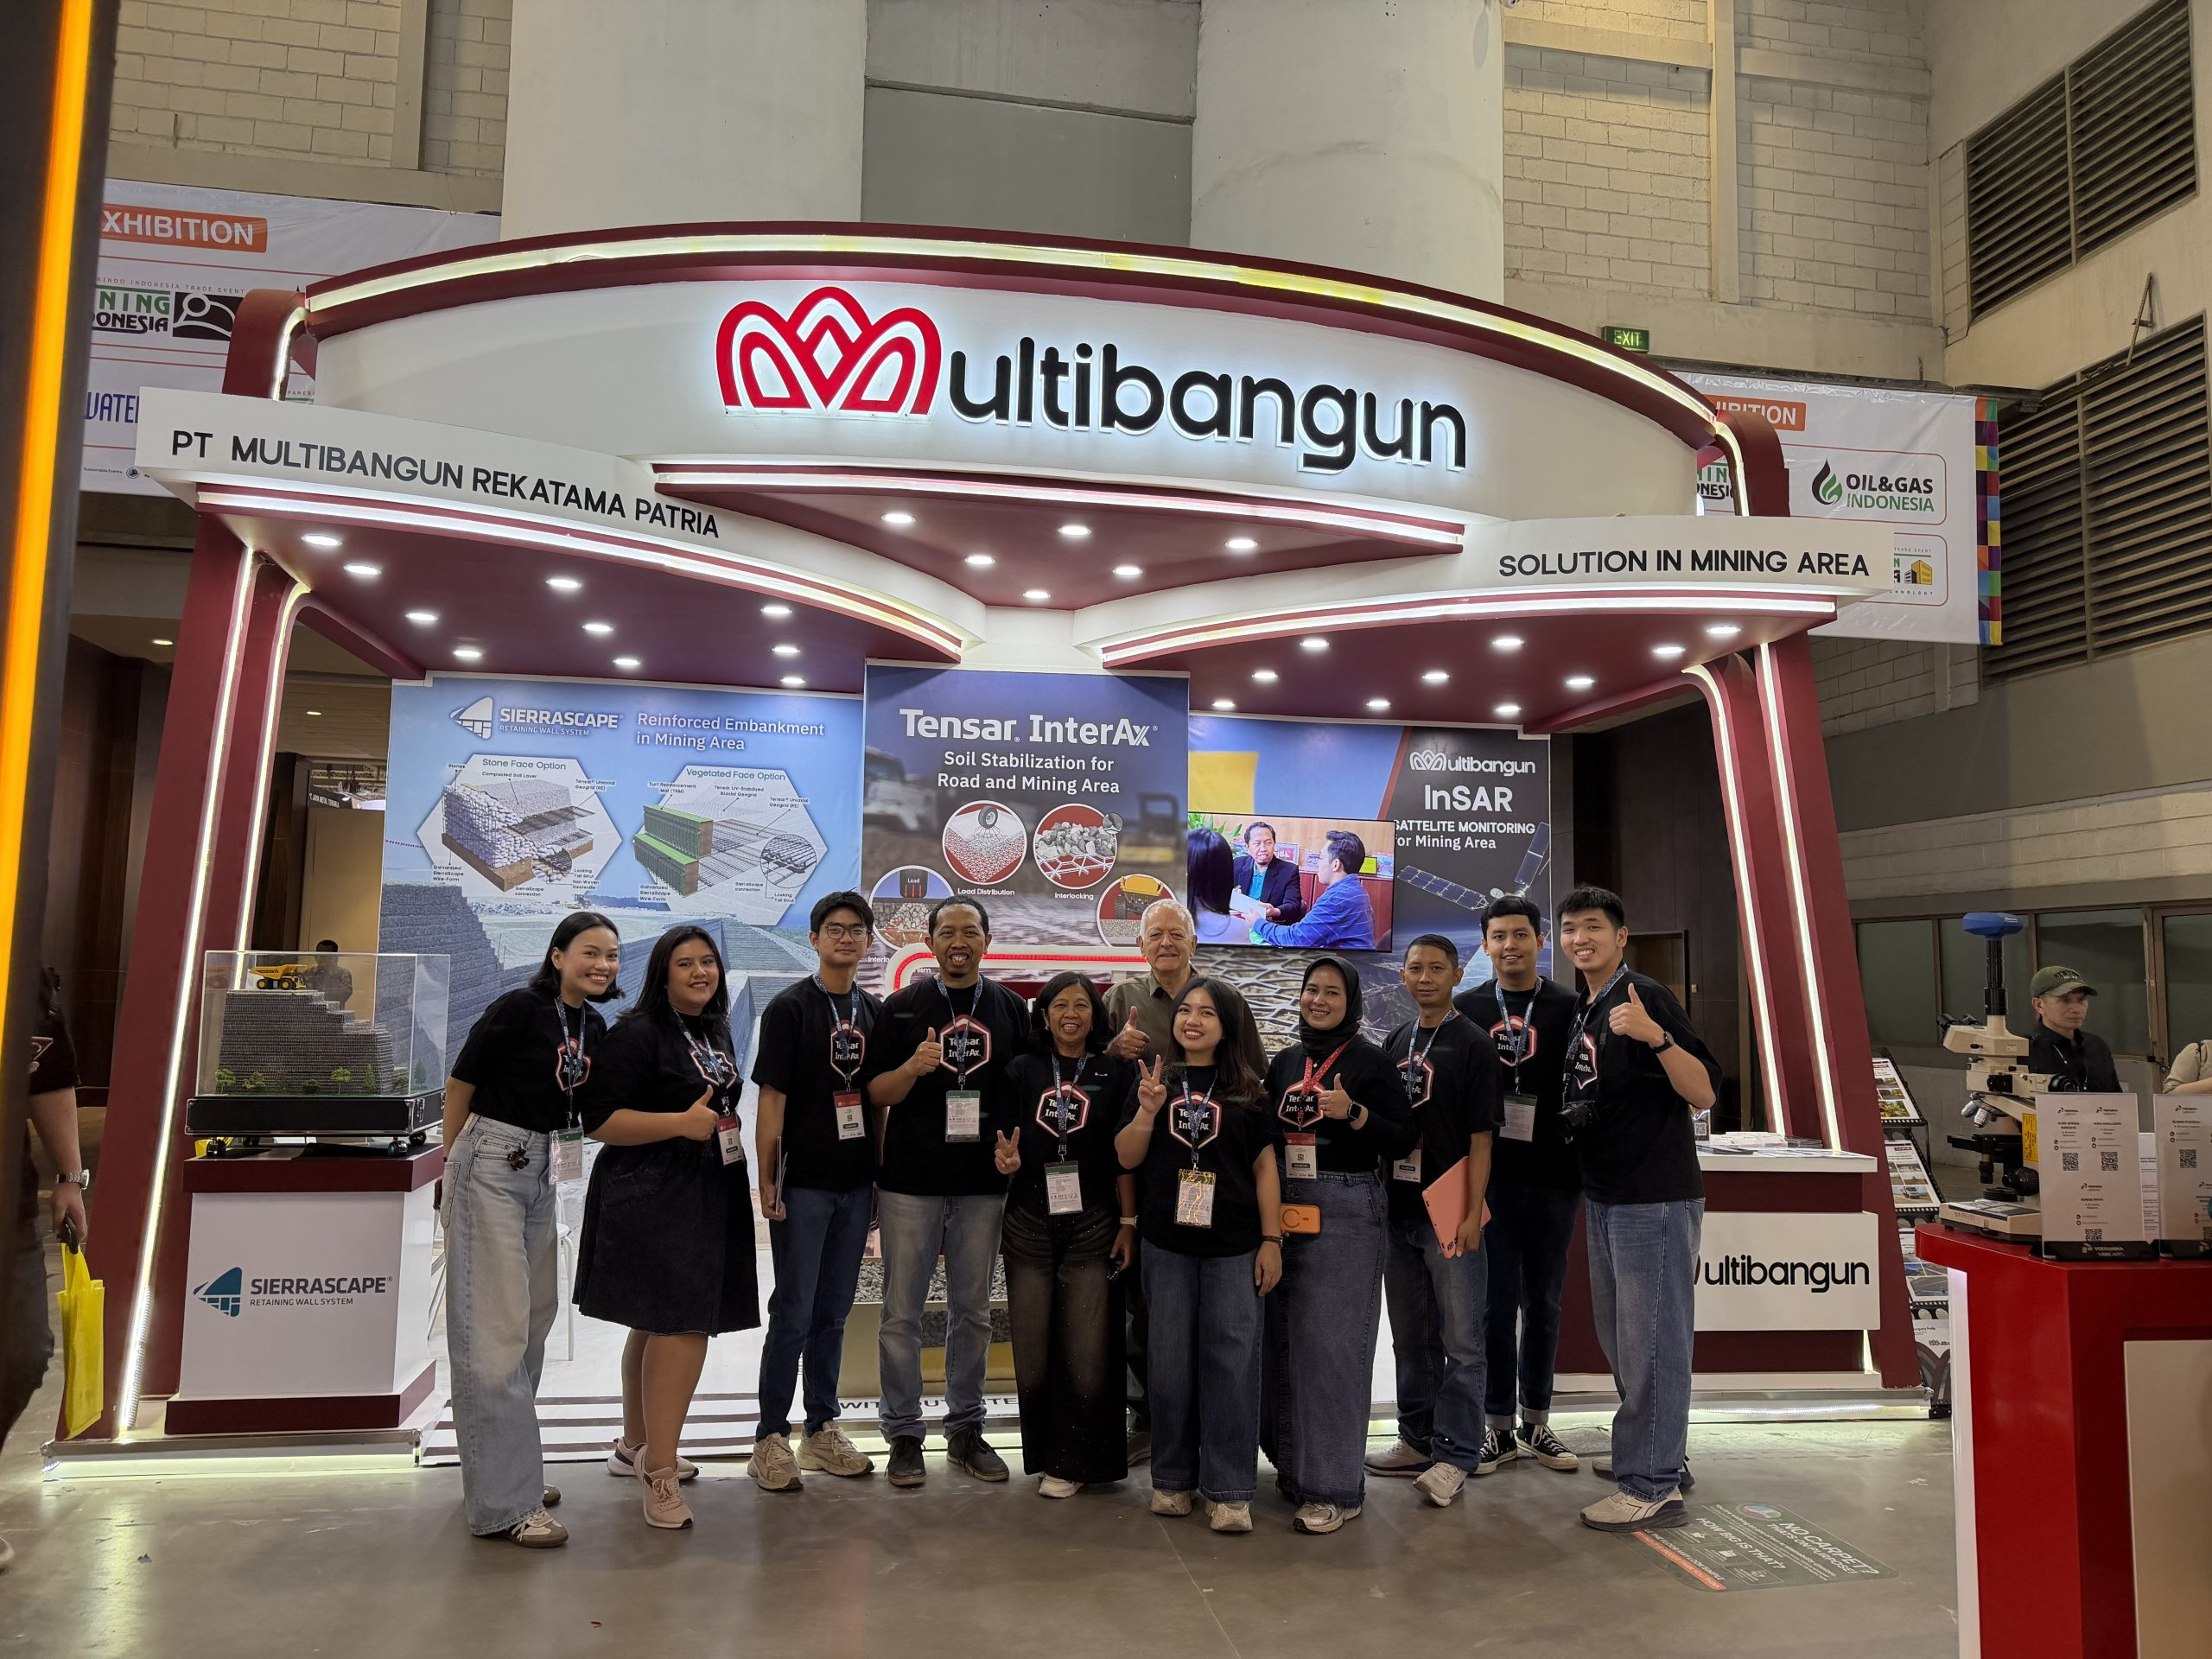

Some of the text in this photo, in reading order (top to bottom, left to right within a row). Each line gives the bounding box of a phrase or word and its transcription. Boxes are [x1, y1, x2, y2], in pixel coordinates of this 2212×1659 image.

[103, 210, 254, 245] XHIBITION
[99, 290, 171, 315] NING
[93, 311, 169, 334] ONESIA
[1614, 330, 1642, 347] EXIT
[172, 429, 720, 539] PT MULTIBANGUN REKATAMA PATRIA
[1846, 474, 1934, 495] OIL&GAS
[1846, 493, 1935, 512] INDONESIA
[1498, 550, 1647, 577] SOLUTION
[1656, 550, 1681, 572] IN
[1691, 550, 1788, 574] MINING
[1797, 551, 1870, 577] AREA
[499, 725, 538, 734] RETAINING
[637, 712, 825, 736] Reinforced Embankment
[636, 731, 746, 751] in Mining Area
[482, 758, 567, 772] Stone Face Option
[944, 751, 1115, 772] Soil Stabilization for
[686, 768, 786, 781] Vegetated Face Option
[938, 772, 1120, 795] Road and Mining Area
[1424, 785, 1513, 812] InSAR
[1395, 820, 1536, 834] SATTELITE MONITORING
[1416, 835, 1461, 850] Mining
[1465, 836, 1497, 849] Area
[980, 887, 1015, 897] Distribution
[1054, 893, 1094, 901] Interlocking
[1695, 1255, 1870, 1293] ultibangun
[1695, 1517, 1726, 1533] HOW
[1719, 1532, 1742, 1543] BIG
[1749, 1548, 1786, 1569] THAT?
[1779, 1522, 1880, 1574] NO CARPET?
[1794, 1538, 1814, 1548] ON
